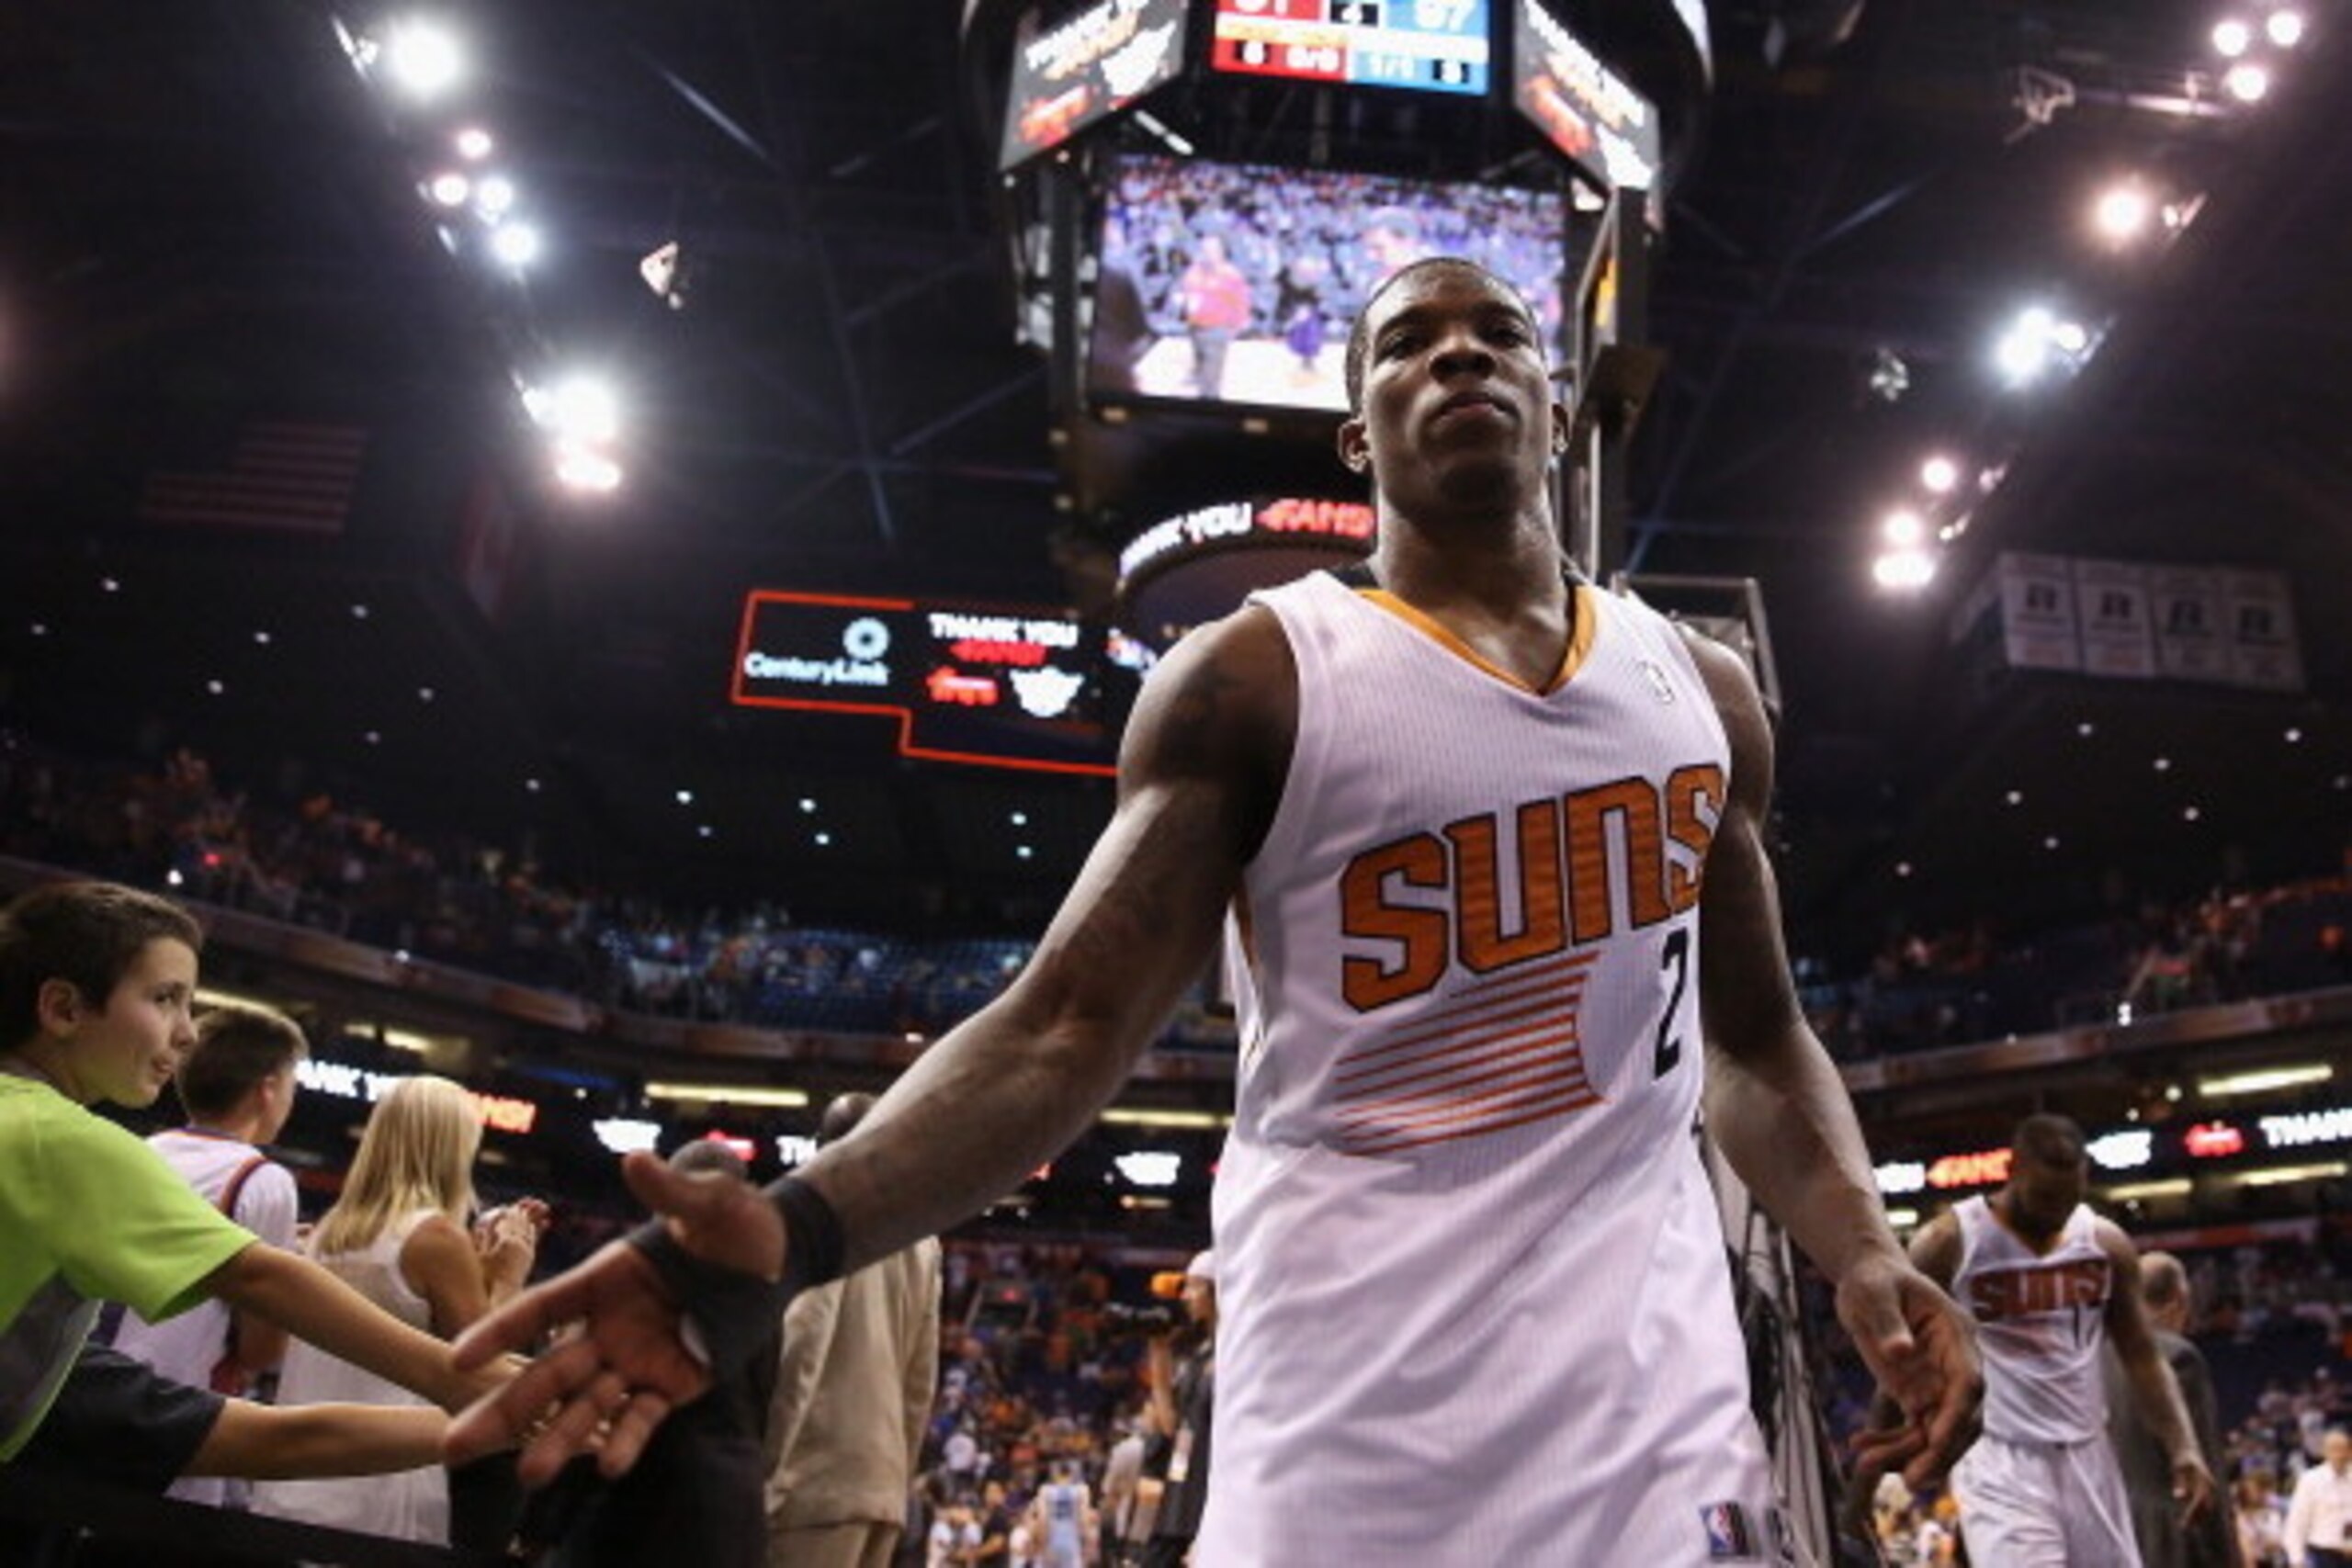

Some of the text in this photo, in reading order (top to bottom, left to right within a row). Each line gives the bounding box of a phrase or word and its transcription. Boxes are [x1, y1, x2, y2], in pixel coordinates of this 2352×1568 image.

[1184, 503, 1252, 542] YOU
[928, 612, 1020, 641] THANK
[743, 651, 890, 686] CenturyLink
[1339, 761, 1724, 1013] SUNS
[1655, 926, 1688, 1082] 2
